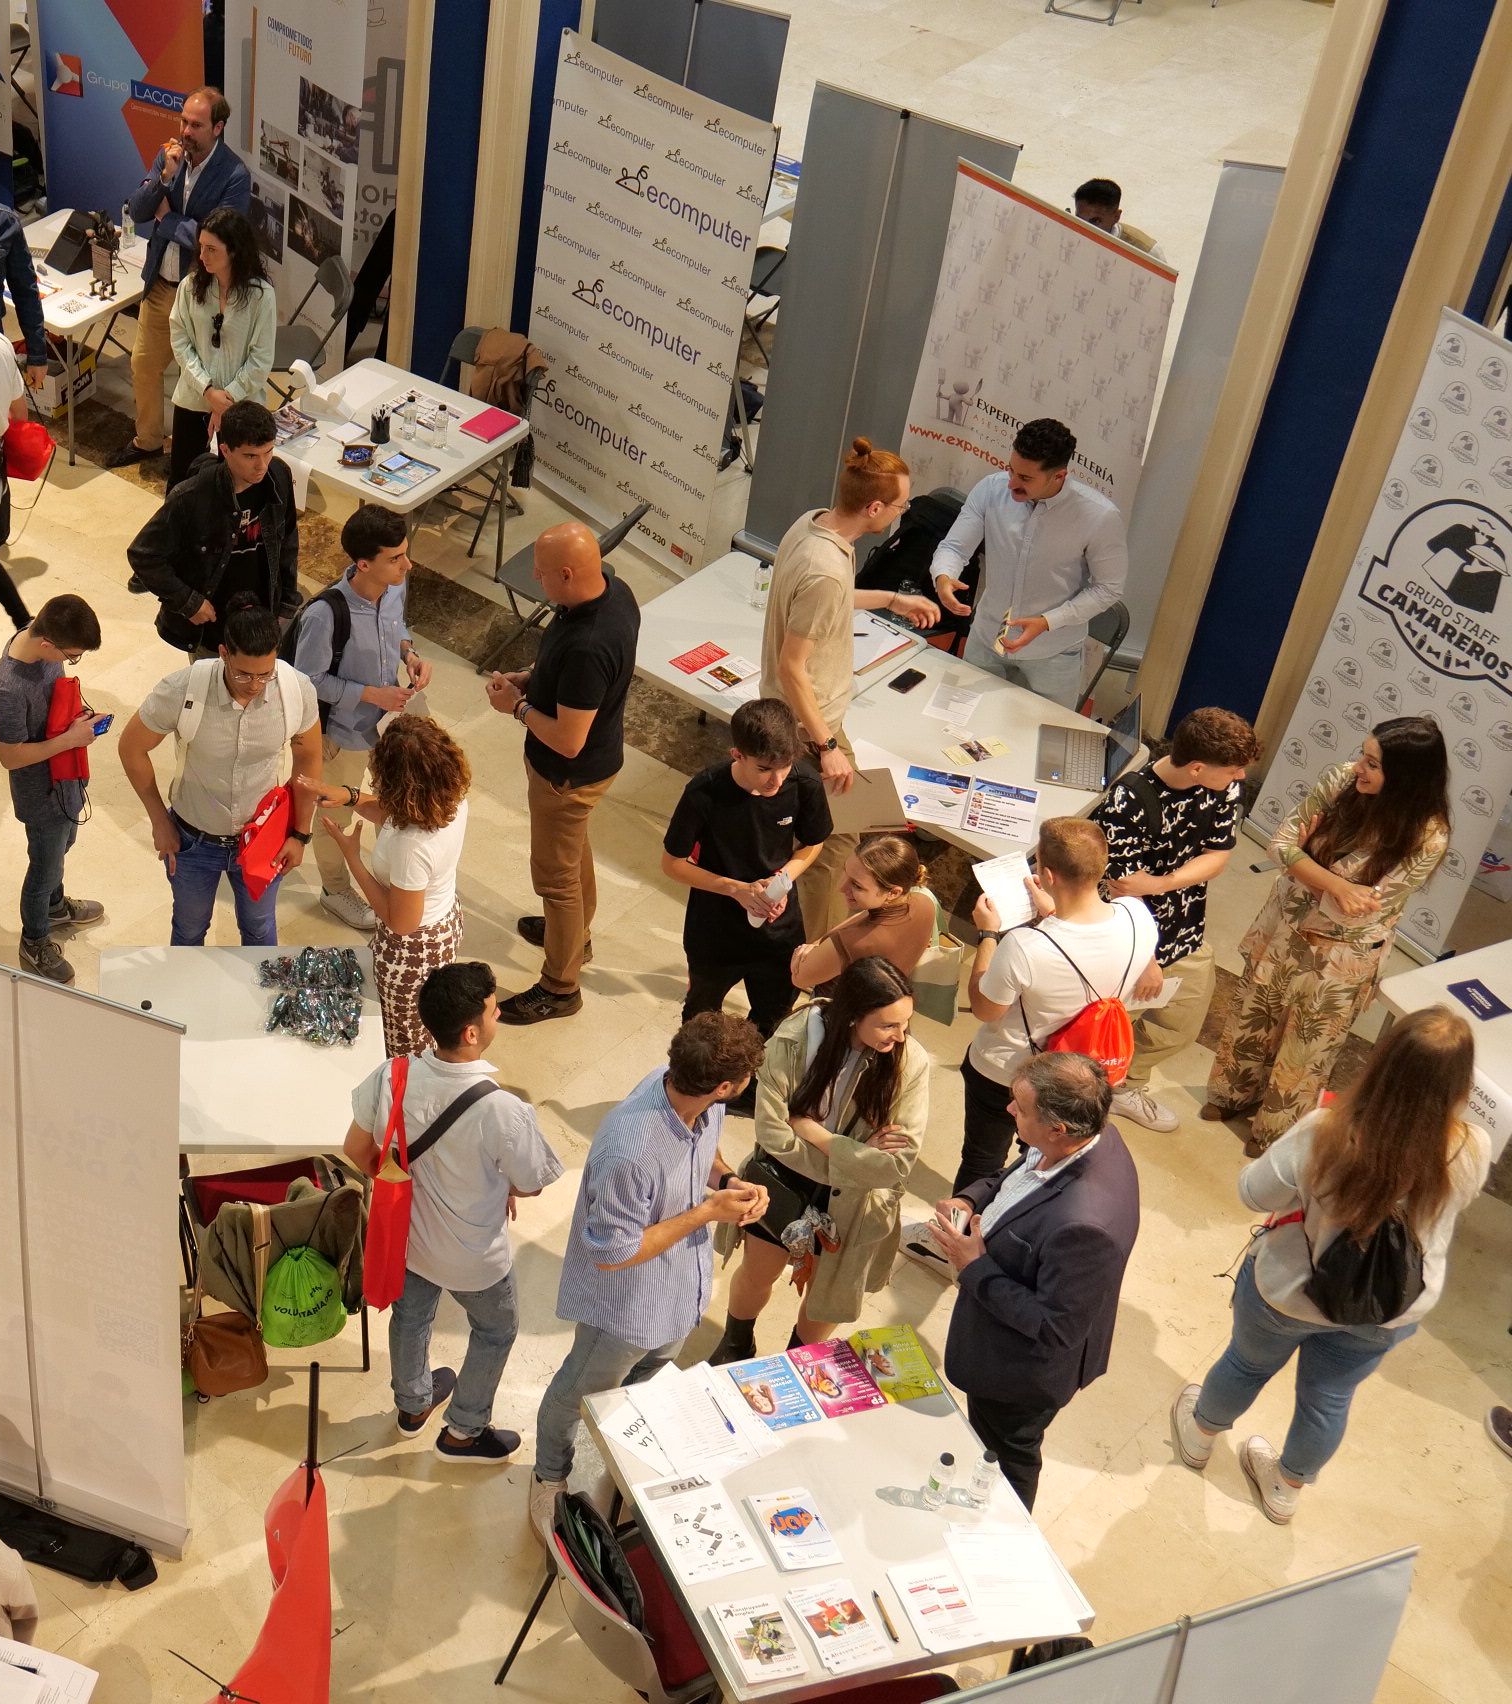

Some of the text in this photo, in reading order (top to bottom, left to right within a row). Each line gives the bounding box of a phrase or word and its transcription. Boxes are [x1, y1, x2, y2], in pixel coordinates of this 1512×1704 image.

[268, 16, 313, 50] COMPROMETIDOS
[288, 42, 312, 65] FUTURO
[87, 71, 128, 91] Grupo
[579, 59, 623, 88] ecomputer
[647, 91, 694, 121] ecomputer
[610, 122, 655, 151] ecomputer
[718, 126, 766, 158] ecomputer
[568, 149, 612, 176] ecomputer
[679, 156, 726, 187] ecomputer
[599, 210, 642, 240] ecomputer
[646, 184, 751, 253] ecomputer
[557, 232, 600, 262] ecomputer
[666, 244, 712, 277] ecomputer
[623, 269, 666, 299] ecomputer
[548, 313, 589, 343] ecomputer
[601, 297, 701, 366] ecomputer
[689, 306, 735, 338] ecomputer
[611, 350, 654, 381] ecomputer
[577, 372, 619, 403] ecomputer
[675, 388, 720, 421] ecomputer
[554, 398, 647, 466] ecomputer
[640, 412, 684, 444] ecomputer
[976, 399, 1114, 485] EXPERTO TELERÍA
[567, 449, 608, 480] ecomputer
[662, 467, 705, 501] ecomputer
[1405, 581, 1500, 646] GRUPO STAFF
[1377, 584, 1512, 680] CAMAREROS
[1487, 1116, 1497, 1129] SL
[923, 1380, 937, 1389] FP
[872, 1396, 885, 1405] FP
[623, 1417, 646, 1438] CIÓN
[804, 1413, 818, 1422] FP
[638, 1436, 653, 1448] LA
